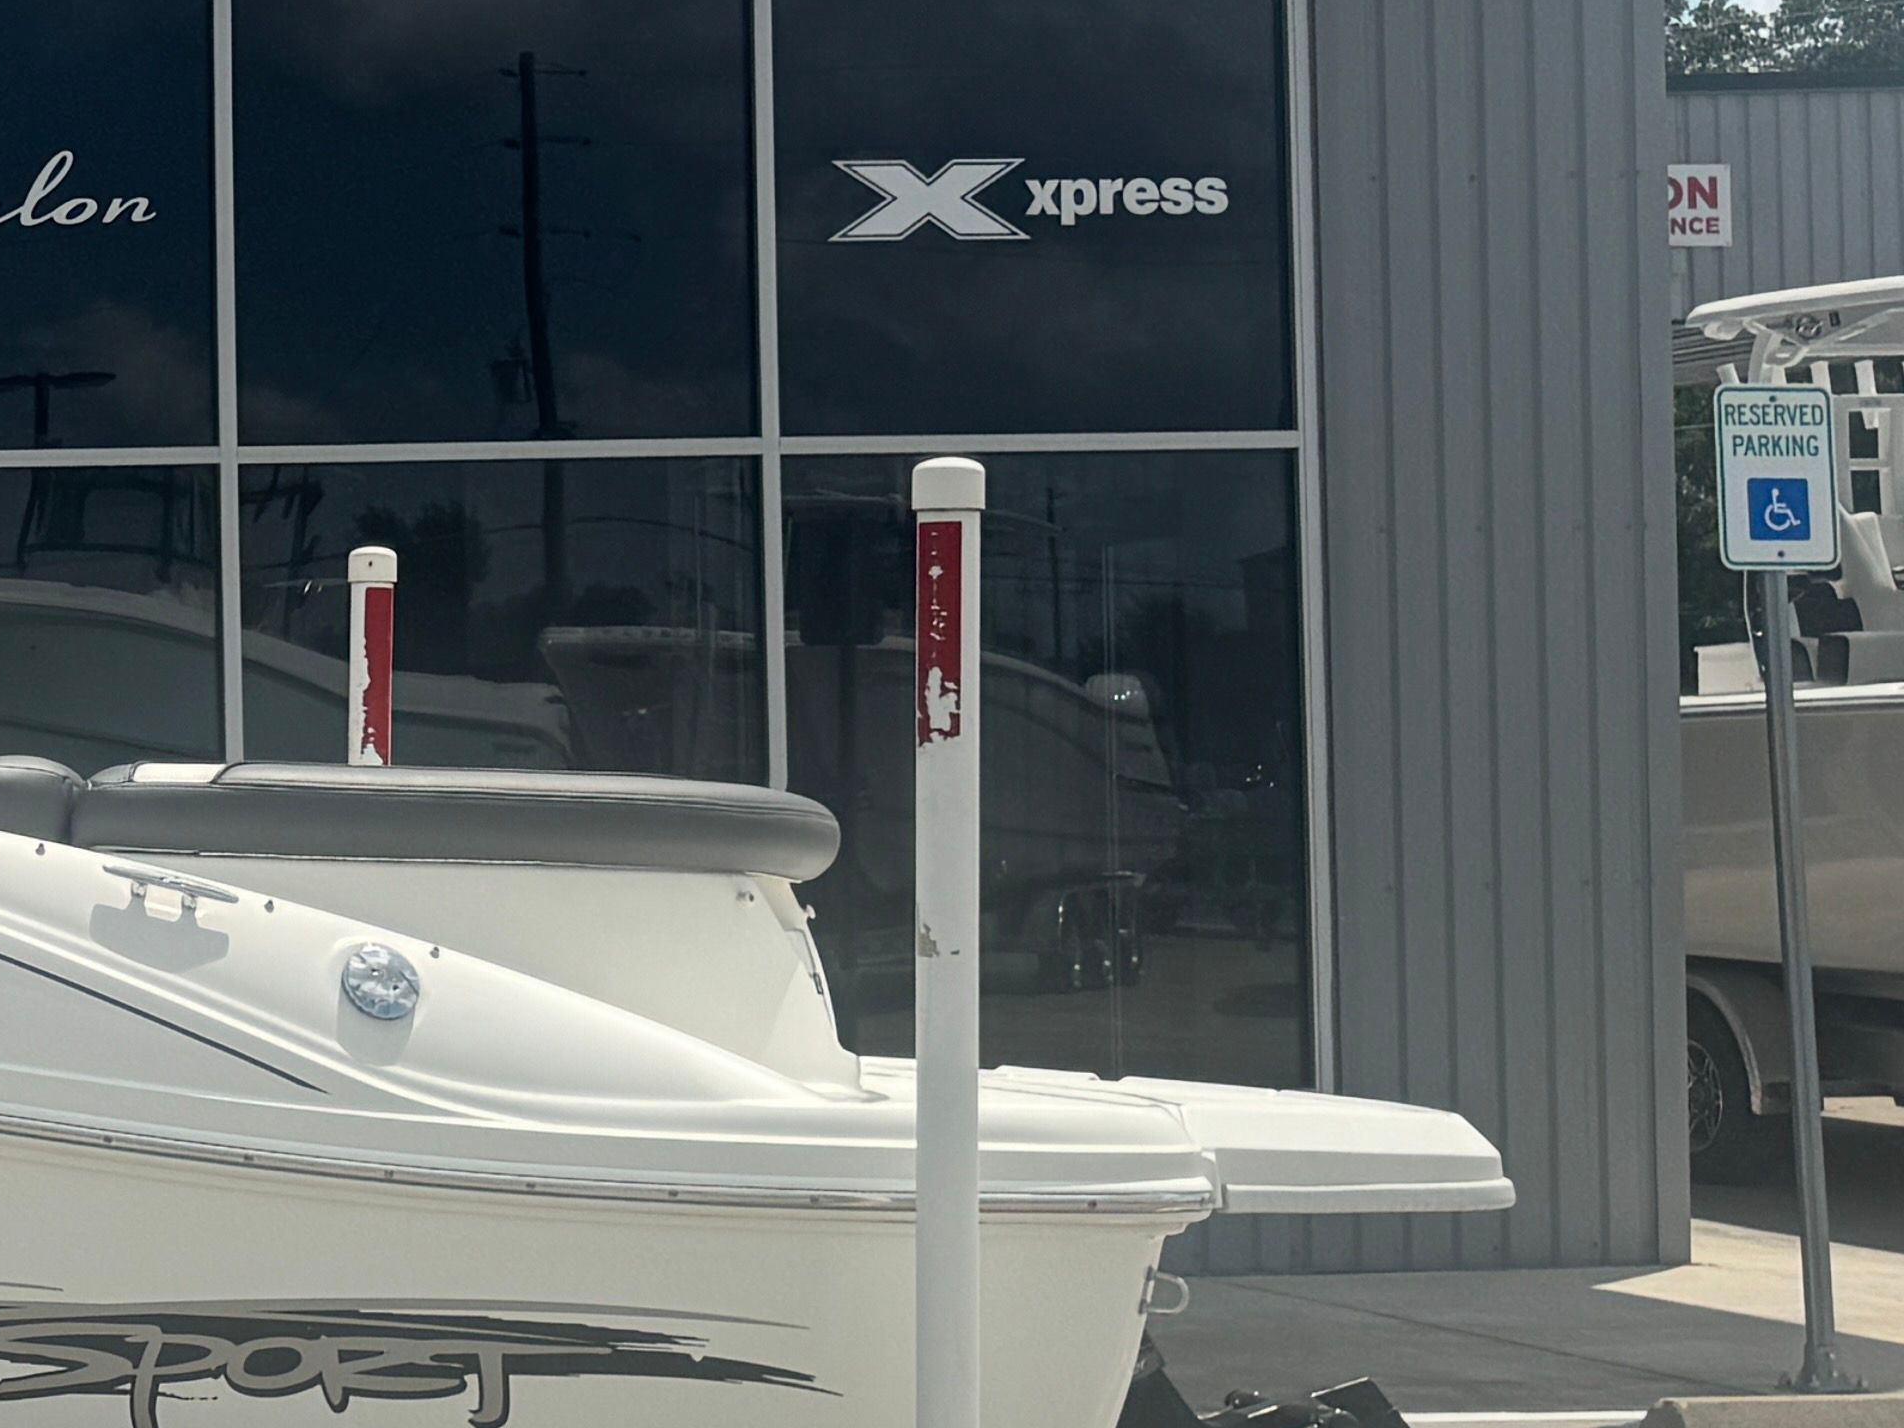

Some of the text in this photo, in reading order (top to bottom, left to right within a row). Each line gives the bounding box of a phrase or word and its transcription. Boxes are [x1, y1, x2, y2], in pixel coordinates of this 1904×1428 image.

[1024, 176, 1229, 226] xpress
[1724, 403, 1824, 427] RESERVED
[1732, 434, 1820, 458] PARKING
